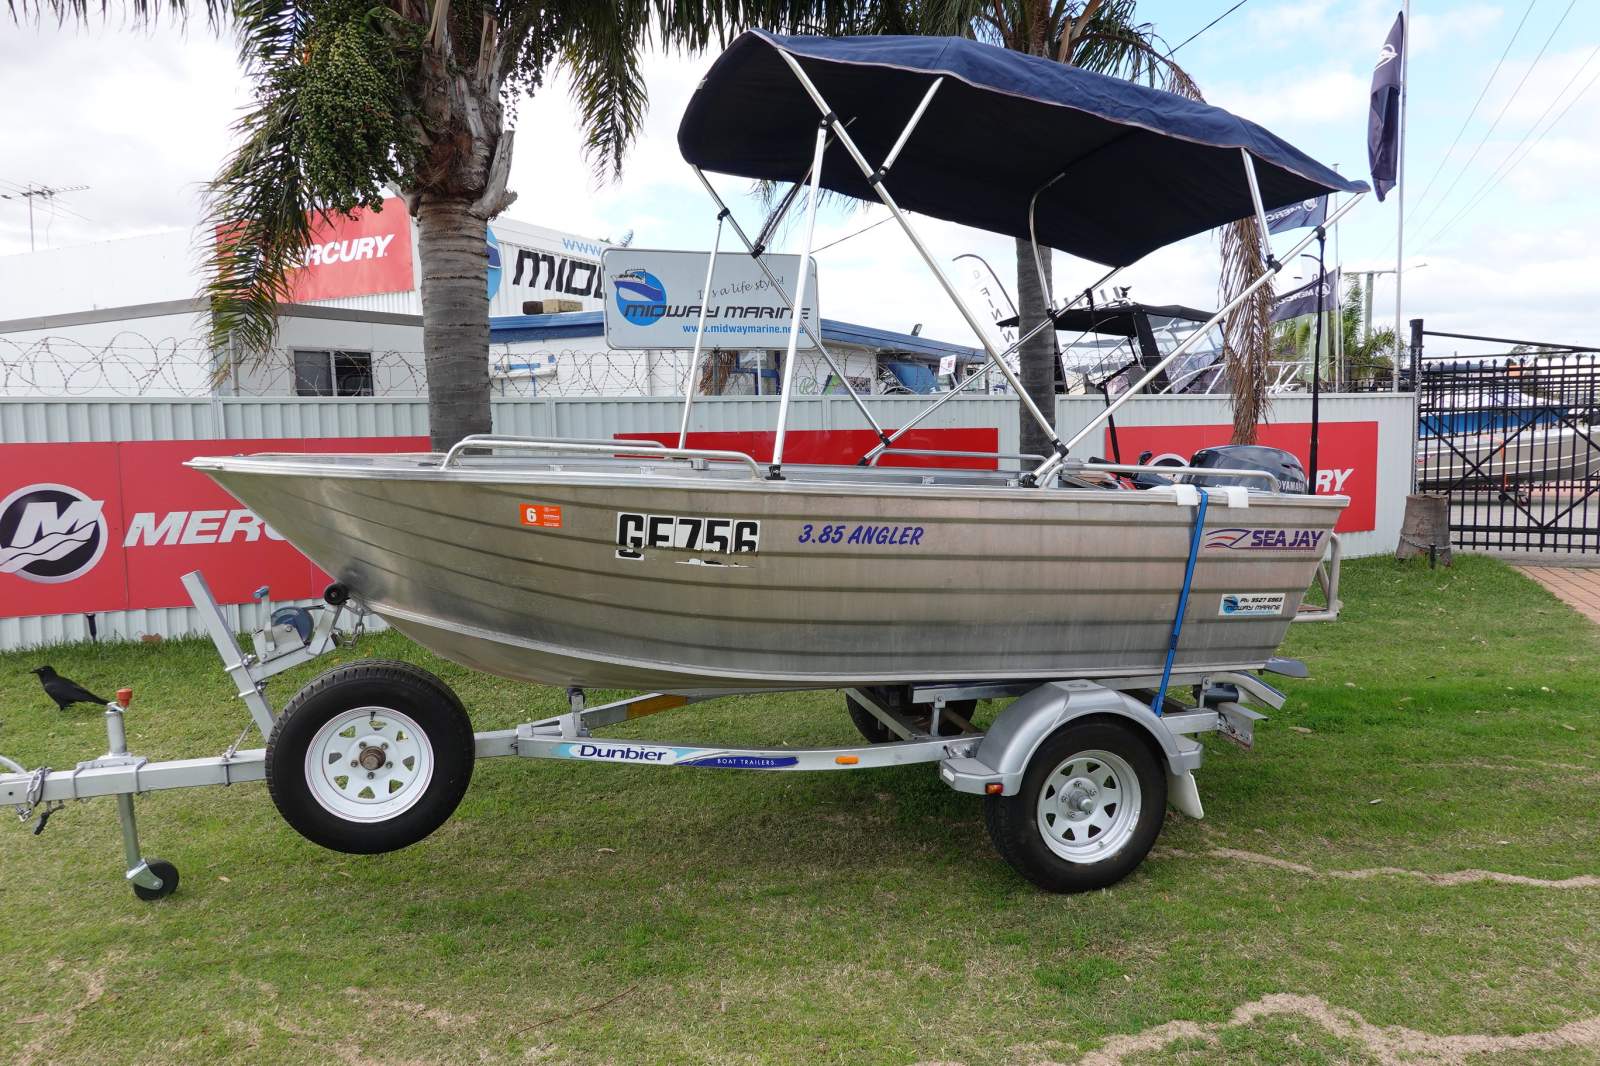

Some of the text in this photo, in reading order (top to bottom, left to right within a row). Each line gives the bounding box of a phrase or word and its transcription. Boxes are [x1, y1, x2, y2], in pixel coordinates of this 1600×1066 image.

[287, 234, 395, 268] RCURY
[512, 249, 603, 299] MID
[731, 281, 753, 294] life
[623, 304, 811, 320] MIDWAY MARINE
[526, 507, 537, 523] 6
[798, 523, 925, 546] 3.85 ANGLER
[1251, 530, 1324, 547] SEA JAY
[579, 744, 667, 761] Dunbier
[740, 758, 774, 766] TRAILERS
